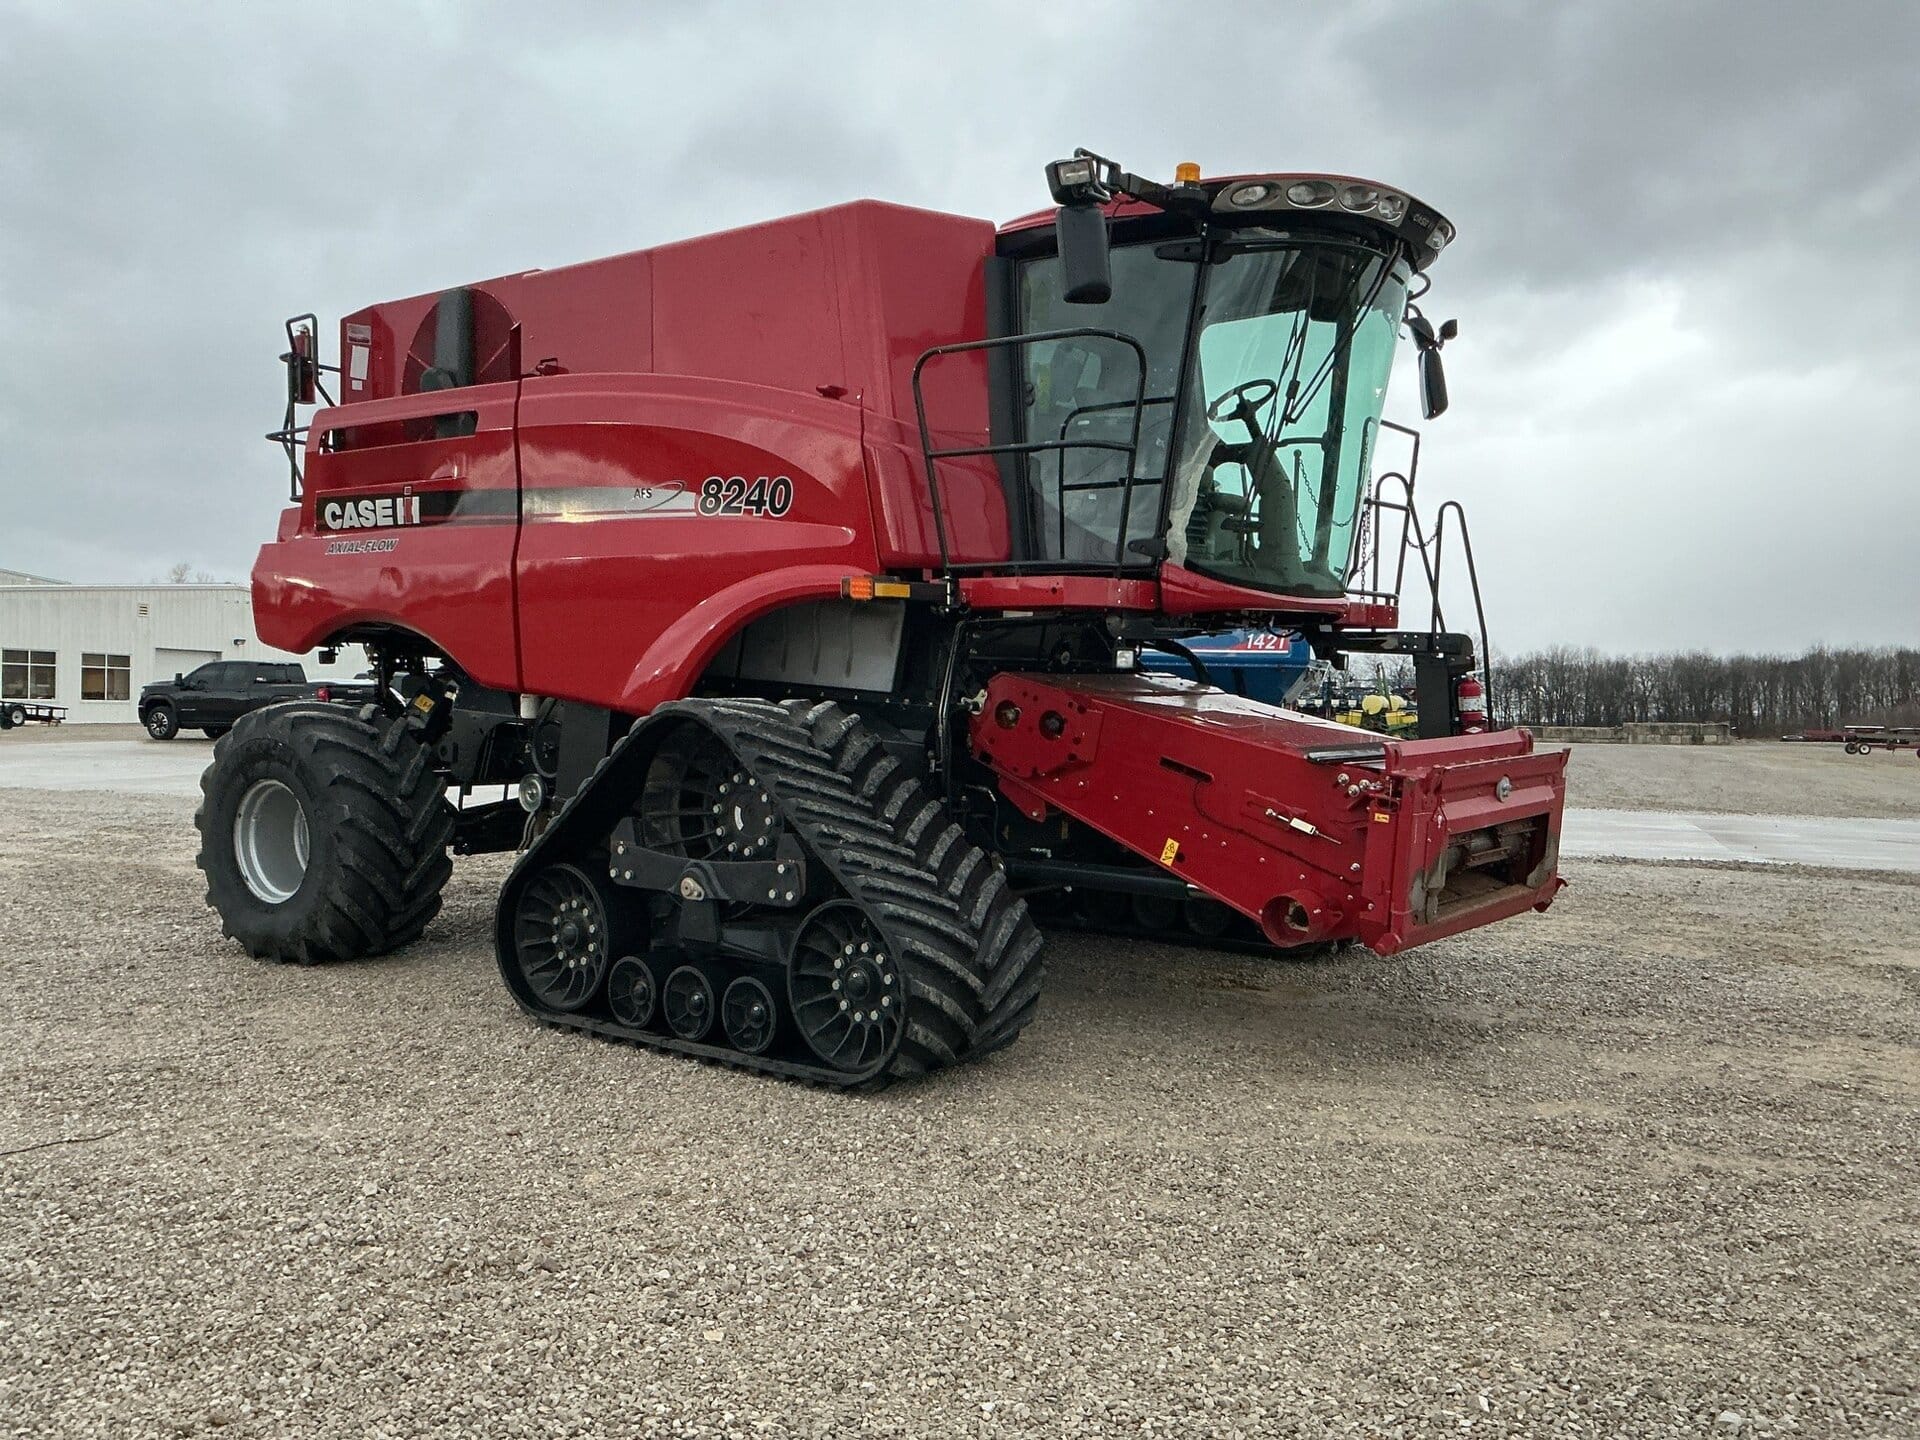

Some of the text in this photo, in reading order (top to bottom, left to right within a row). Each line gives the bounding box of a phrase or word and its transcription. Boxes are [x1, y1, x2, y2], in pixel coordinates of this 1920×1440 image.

[634, 488, 652, 498] AFS
[698, 476, 793, 517] 8240
[325, 538, 399, 555] AXIAL-FLOW
